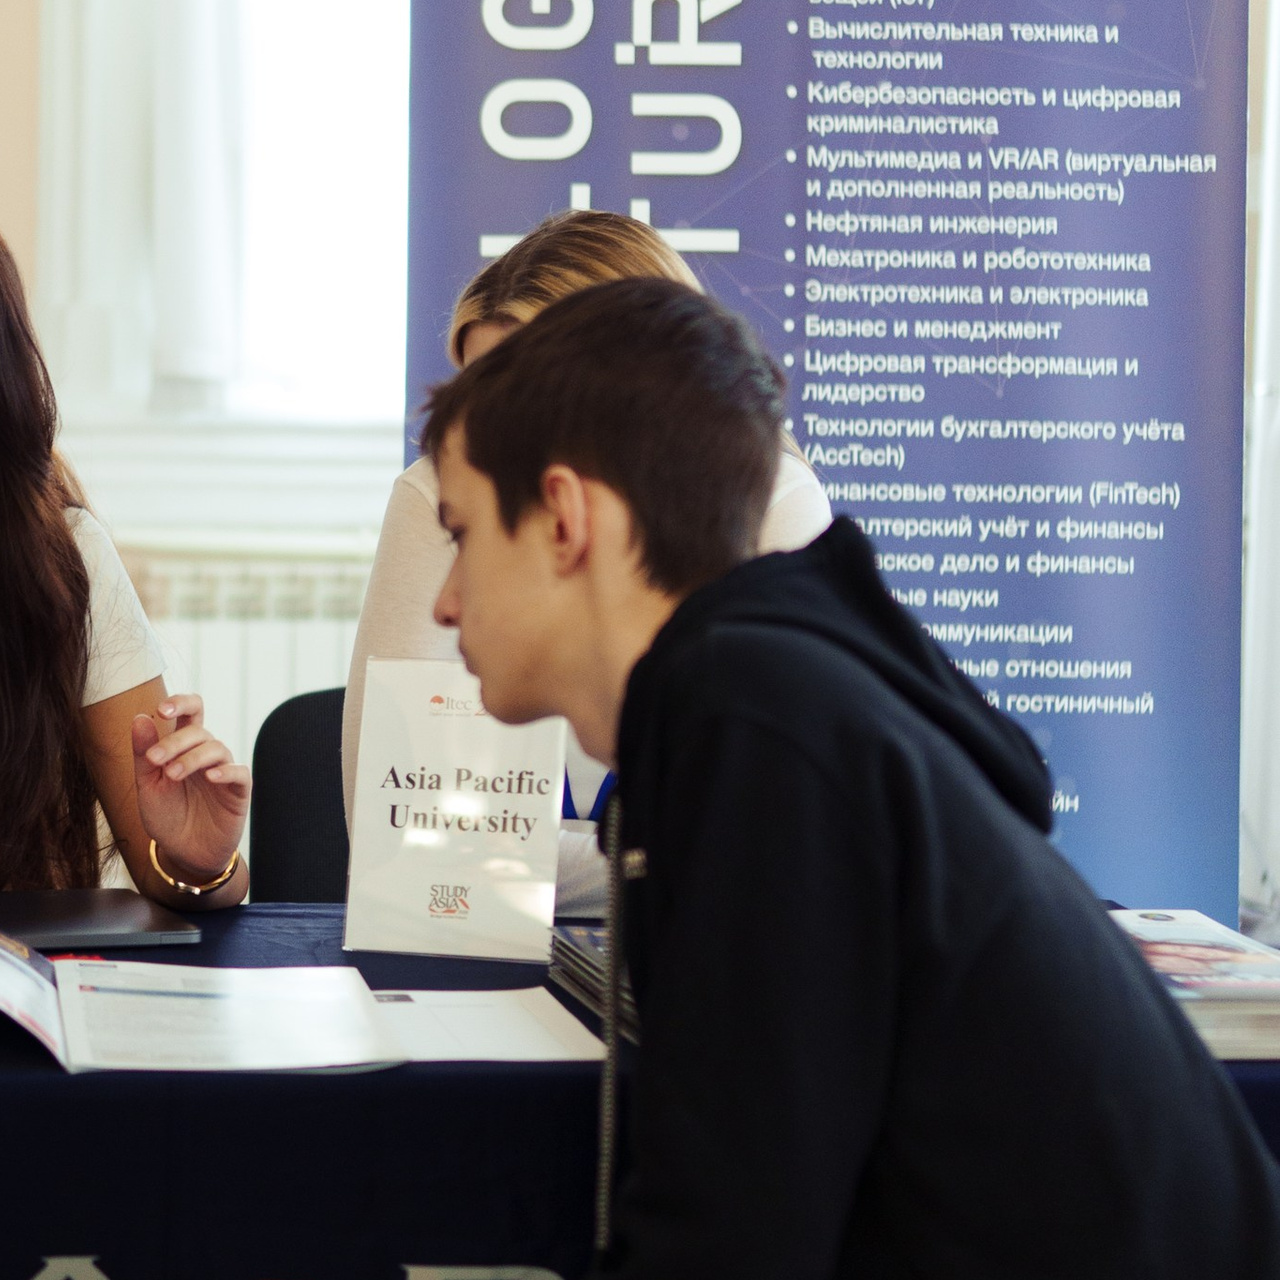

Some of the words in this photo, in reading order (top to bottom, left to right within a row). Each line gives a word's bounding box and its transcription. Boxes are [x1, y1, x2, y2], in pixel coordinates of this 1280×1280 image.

[808, 17, 1003, 42] Вычислительная
[1010, 23, 1099, 44] техника
[1105, 27, 1119, 44] и
[813, 50, 943, 71] технологии
[807, 81, 1036, 110] Кибербезопасность
[1042, 88, 1056, 106] и
[1063, 87, 1181, 113] цифровая
[807, 115, 998, 138] криминалистика
[806, 146, 961, 172] Мультимедиа
[967, 153, 982, 170] и
[988, 148, 1059, 171] VR/AR
[1065, 150, 1217, 177] (виртуальная
[806, 180, 821, 197] и
[827, 180, 982, 201] дополненная
[988, 180, 1124, 206] реальность)
[806, 211, 923, 236] Нефтяная
[930, 216, 1058, 239] инженерия
[806, 245, 956, 272] Мехатроника
[963, 252, 977, 269] и
[984, 247, 1151, 274] робототехника
[805, 280, 983, 307] Электротехника
[990, 286, 1004, 304] и
[1010, 286, 1149, 309] электроника
[805, 314, 887, 338] Бизнес
[894, 320, 908, 337] и
[915, 321, 1062, 342] менеджмент
[804, 349, 926, 375] Цифровая
[932, 353, 1118, 379] трансформация
[1124, 358, 1139, 375] и
[802, 383, 926, 405] лидерство
[803, 413, 934, 440] Технологии
[940, 416, 1116, 443] бухгалтерского
[1122, 417, 1186, 444] учёта
[823, 482, 946, 502] инансовые
[953, 480, 1083, 505] технологии
[1089, 481, 1181, 508] (FinTech)
[853, 514, 972, 541] алтерский
[979, 516, 1030, 542] учёт
[1036, 521, 1050, 538] и
[1056, 518, 1164, 542] финансы
[940, 553, 999, 575] дело
[1005, 555, 1019, 572] и
[1026, 554, 1135, 577] финансы
[933, 588, 999, 612] науки
[1005, 658, 1132, 679] отношения
[1006, 691, 1154, 715] гостиничный
[380, 765, 442, 791] Asia
[454, 768, 551, 796] Pacific
[389, 803, 538, 841] University
